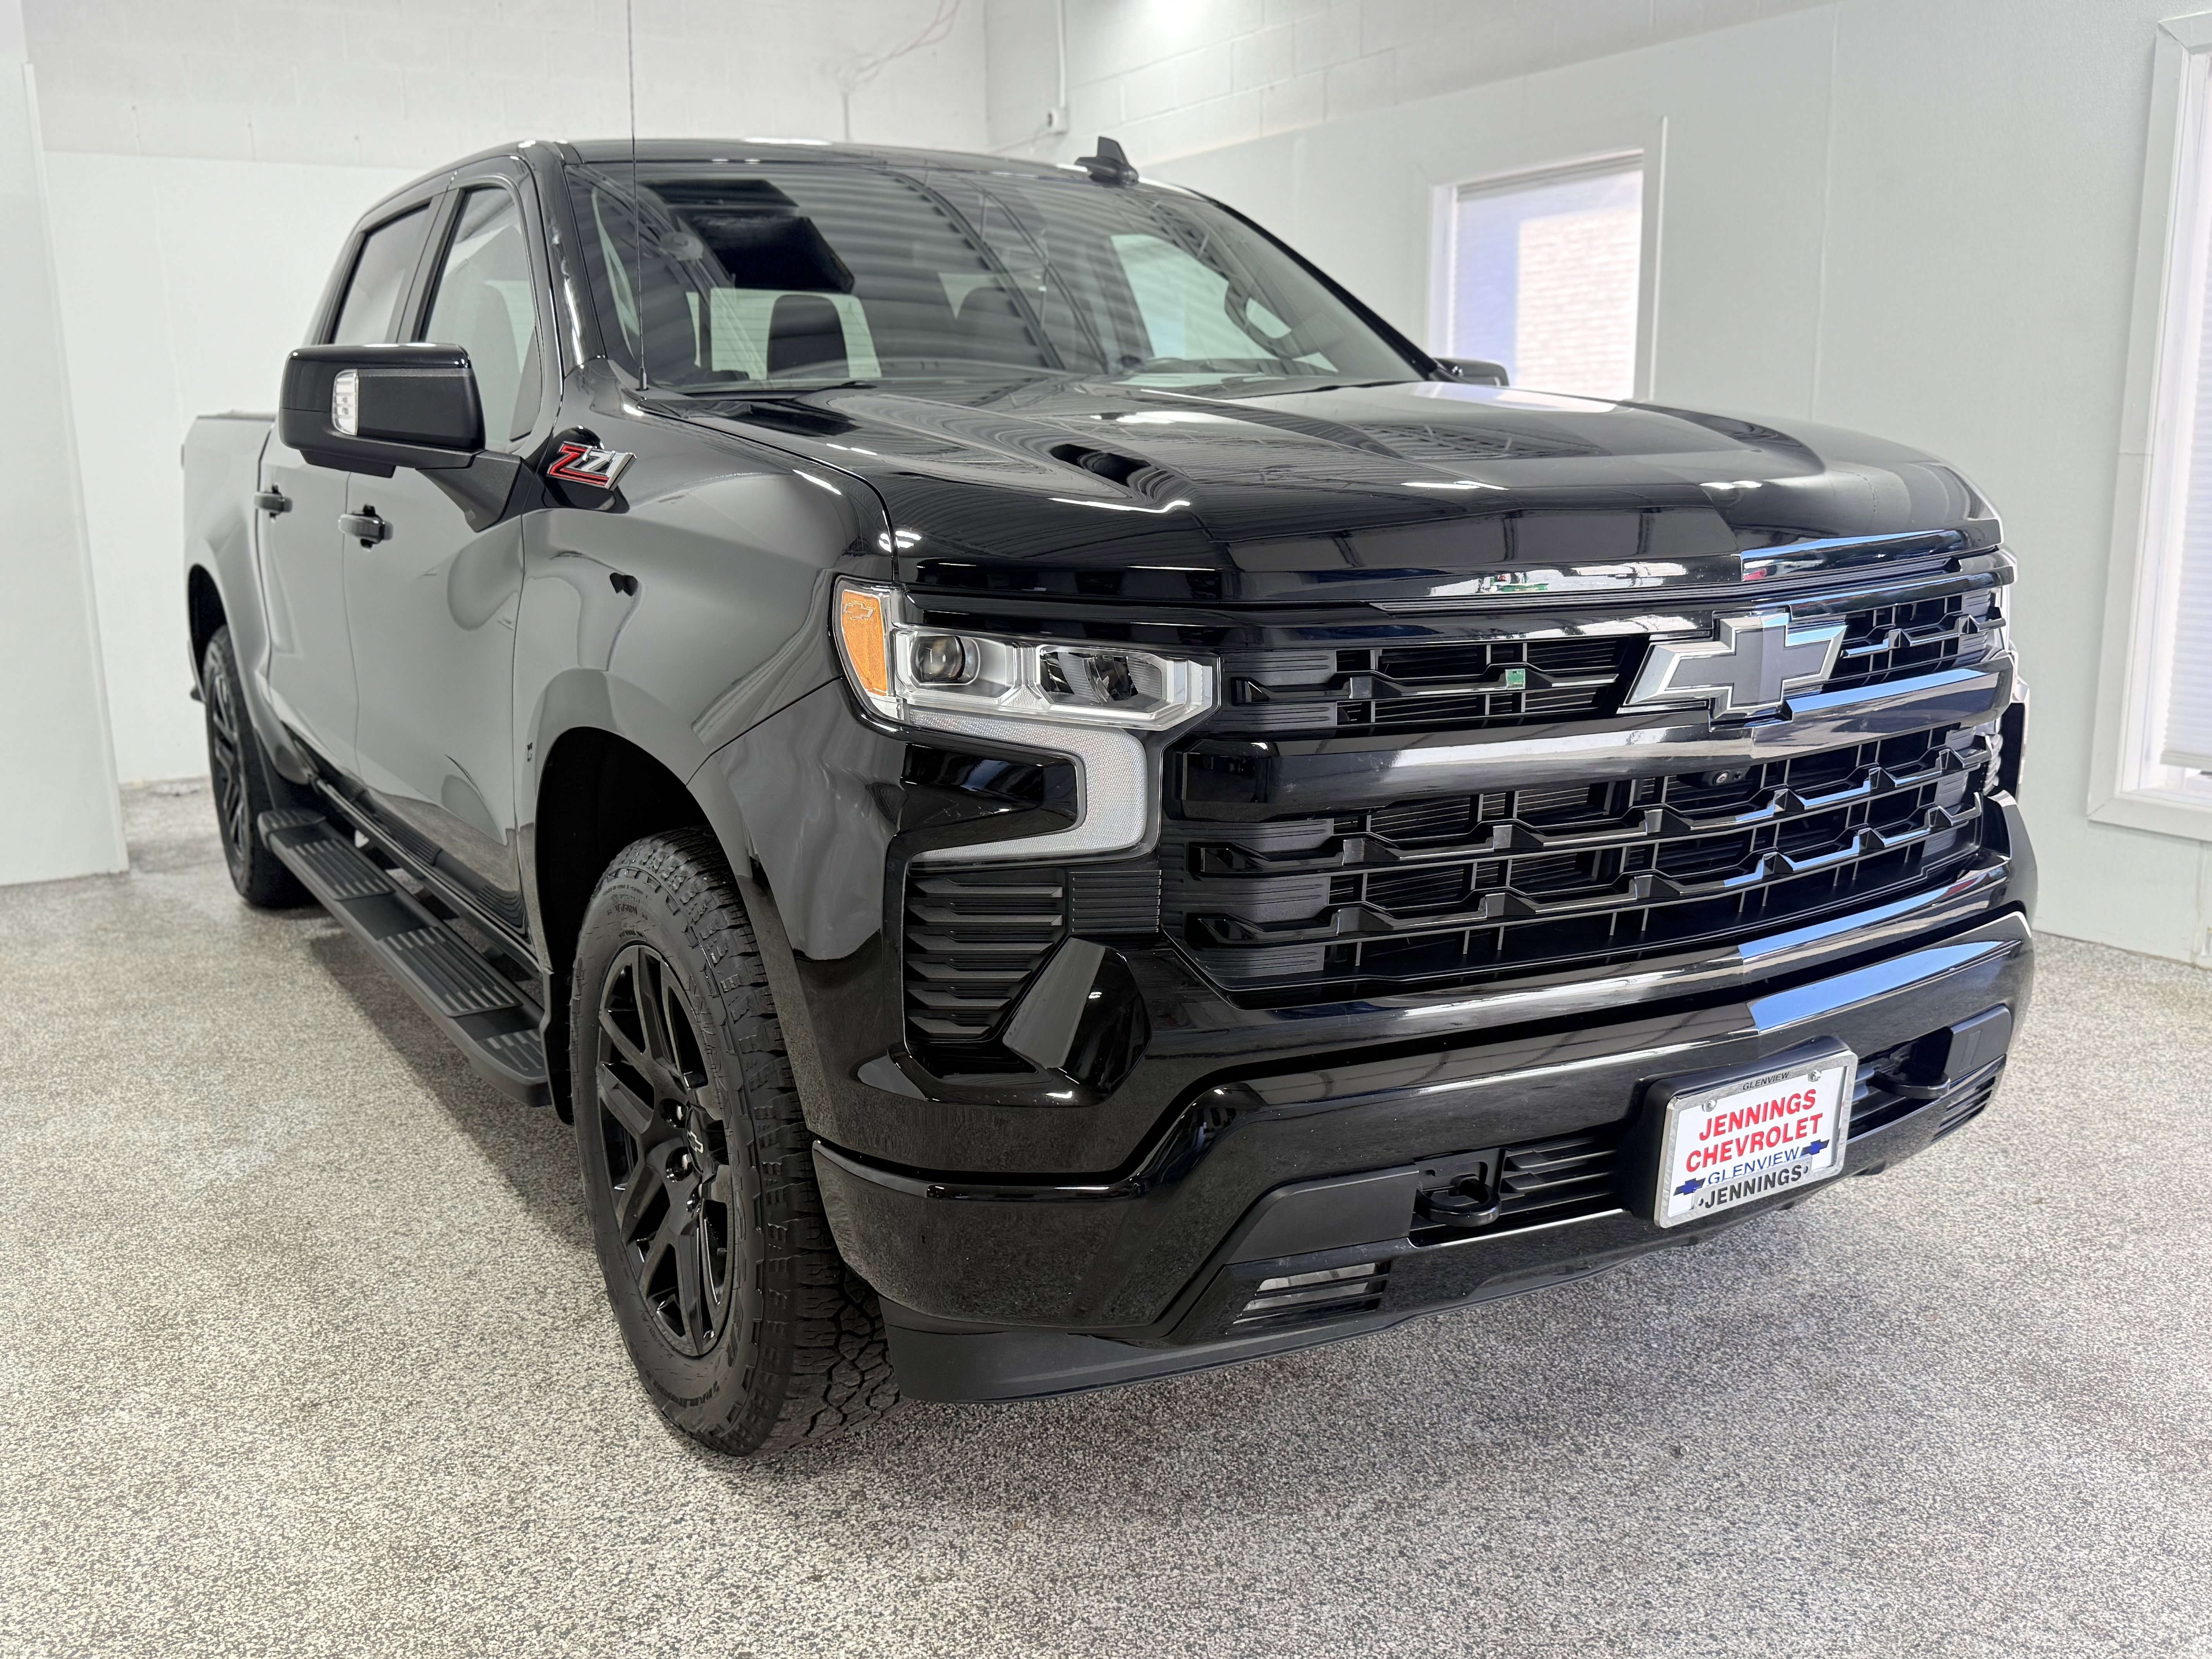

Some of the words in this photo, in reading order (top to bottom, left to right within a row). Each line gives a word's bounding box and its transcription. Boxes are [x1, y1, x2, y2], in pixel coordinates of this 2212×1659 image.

[545, 440, 637, 491] Z71
[1743, 1071, 1790, 1090] GLENVIEW
[1699, 1089, 1816, 1141] JENNINGS
[1686, 1113, 1823, 1173] CHEVROLET
[1708, 1146, 1799, 1185] GLENVIEW
[1705, 1164, 1802, 1208] JENNINGS
